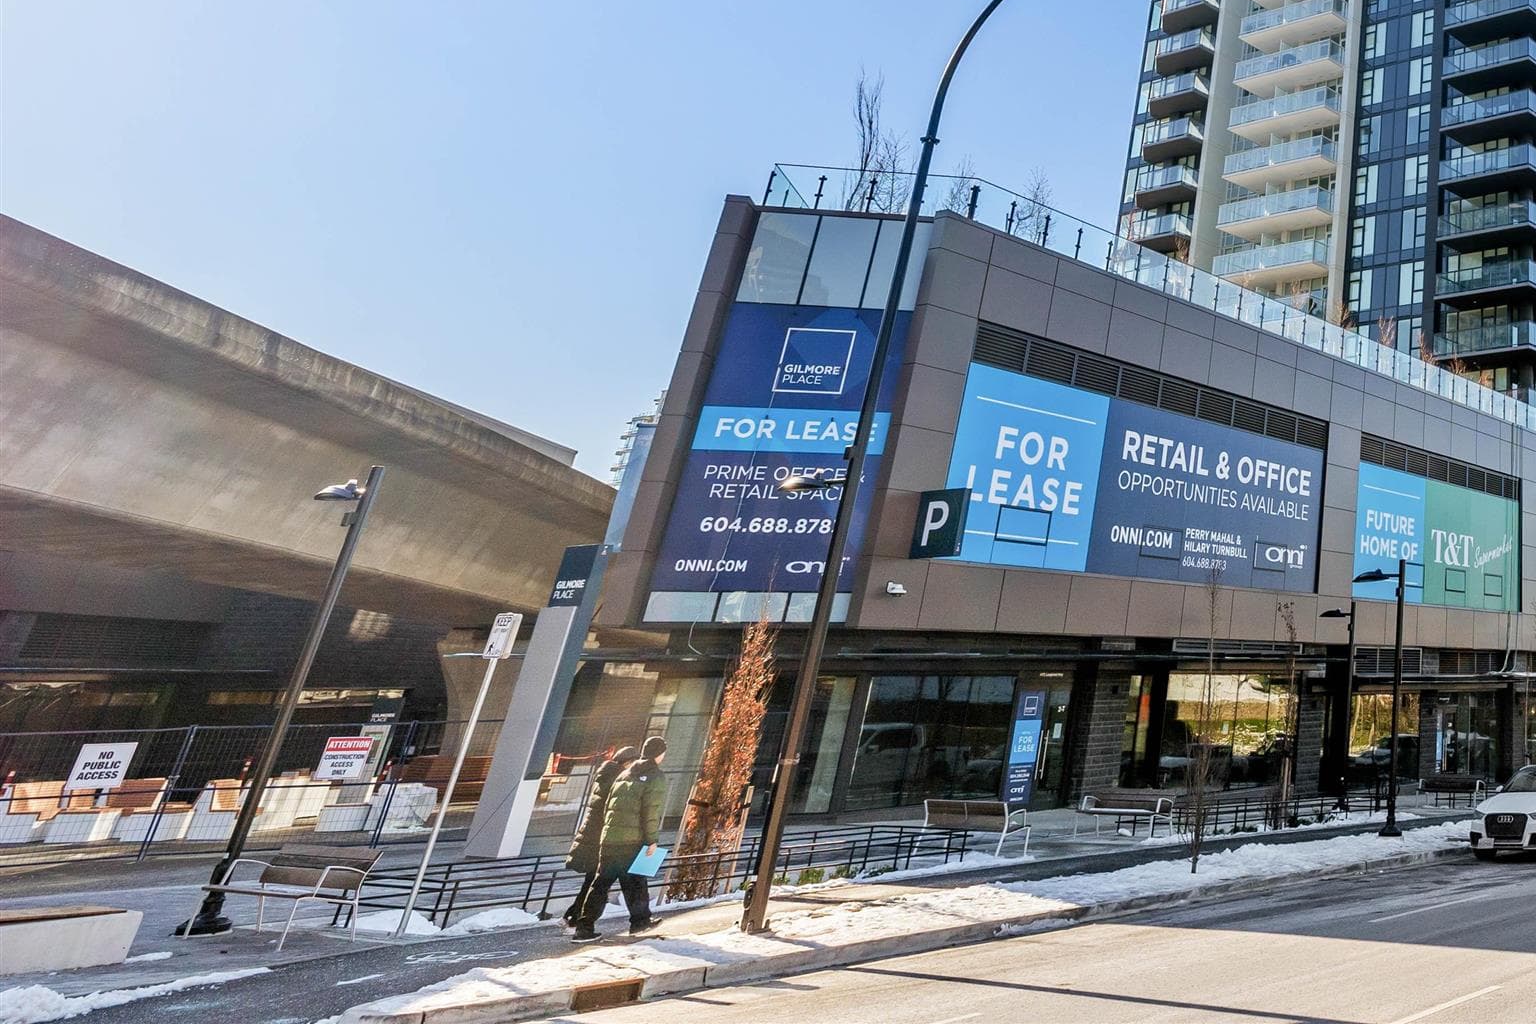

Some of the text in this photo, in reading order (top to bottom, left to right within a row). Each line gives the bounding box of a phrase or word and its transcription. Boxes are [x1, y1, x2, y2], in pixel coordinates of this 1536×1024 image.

[784, 363, 841, 376] GILMORE
[782, 374, 822, 385] PLACE
[714, 417, 777, 440] FOR
[995, 425, 1069, 471] FOR
[1121, 429, 1312, 497] RETAIL & OFFICE
[703, 464, 768, 481] PRIME
[774, 466, 848, 482] OFFCE
[709, 483, 844, 501] RETAIL SPAC
[966, 464, 1082, 515] LEASE
[1118, 470, 1309, 521] OPPORTUNITIES AVAILABLE
[700, 517, 837, 534] 604.688.878
[920, 500, 950, 547] P
[1366, 509, 1415, 537] FUTURE
[1110, 525, 1173, 549] ONNI.COM
[1186, 527, 1242, 545] PERRY MAHAL &
[1184, 540, 1248, 559] HILARY TURNBULL
[1360, 535, 1418, 561] HOME OF
[1431, 528, 1514, 572] T&T Supermarket
[674, 559, 749, 573] ONNI.COM
[555, 579, 586, 589] GILMORE
[552, 589, 576, 599] PLACE
[327, 740, 372, 749] ATTENTION
[1014, 744, 1036, 753] LEASE
[1018, 736, 1033, 744] FOR
[98, 751, 114, 759] NO
[82, 760, 122, 770] PUBLIC
[75, 771, 119, 780] ACCESS
